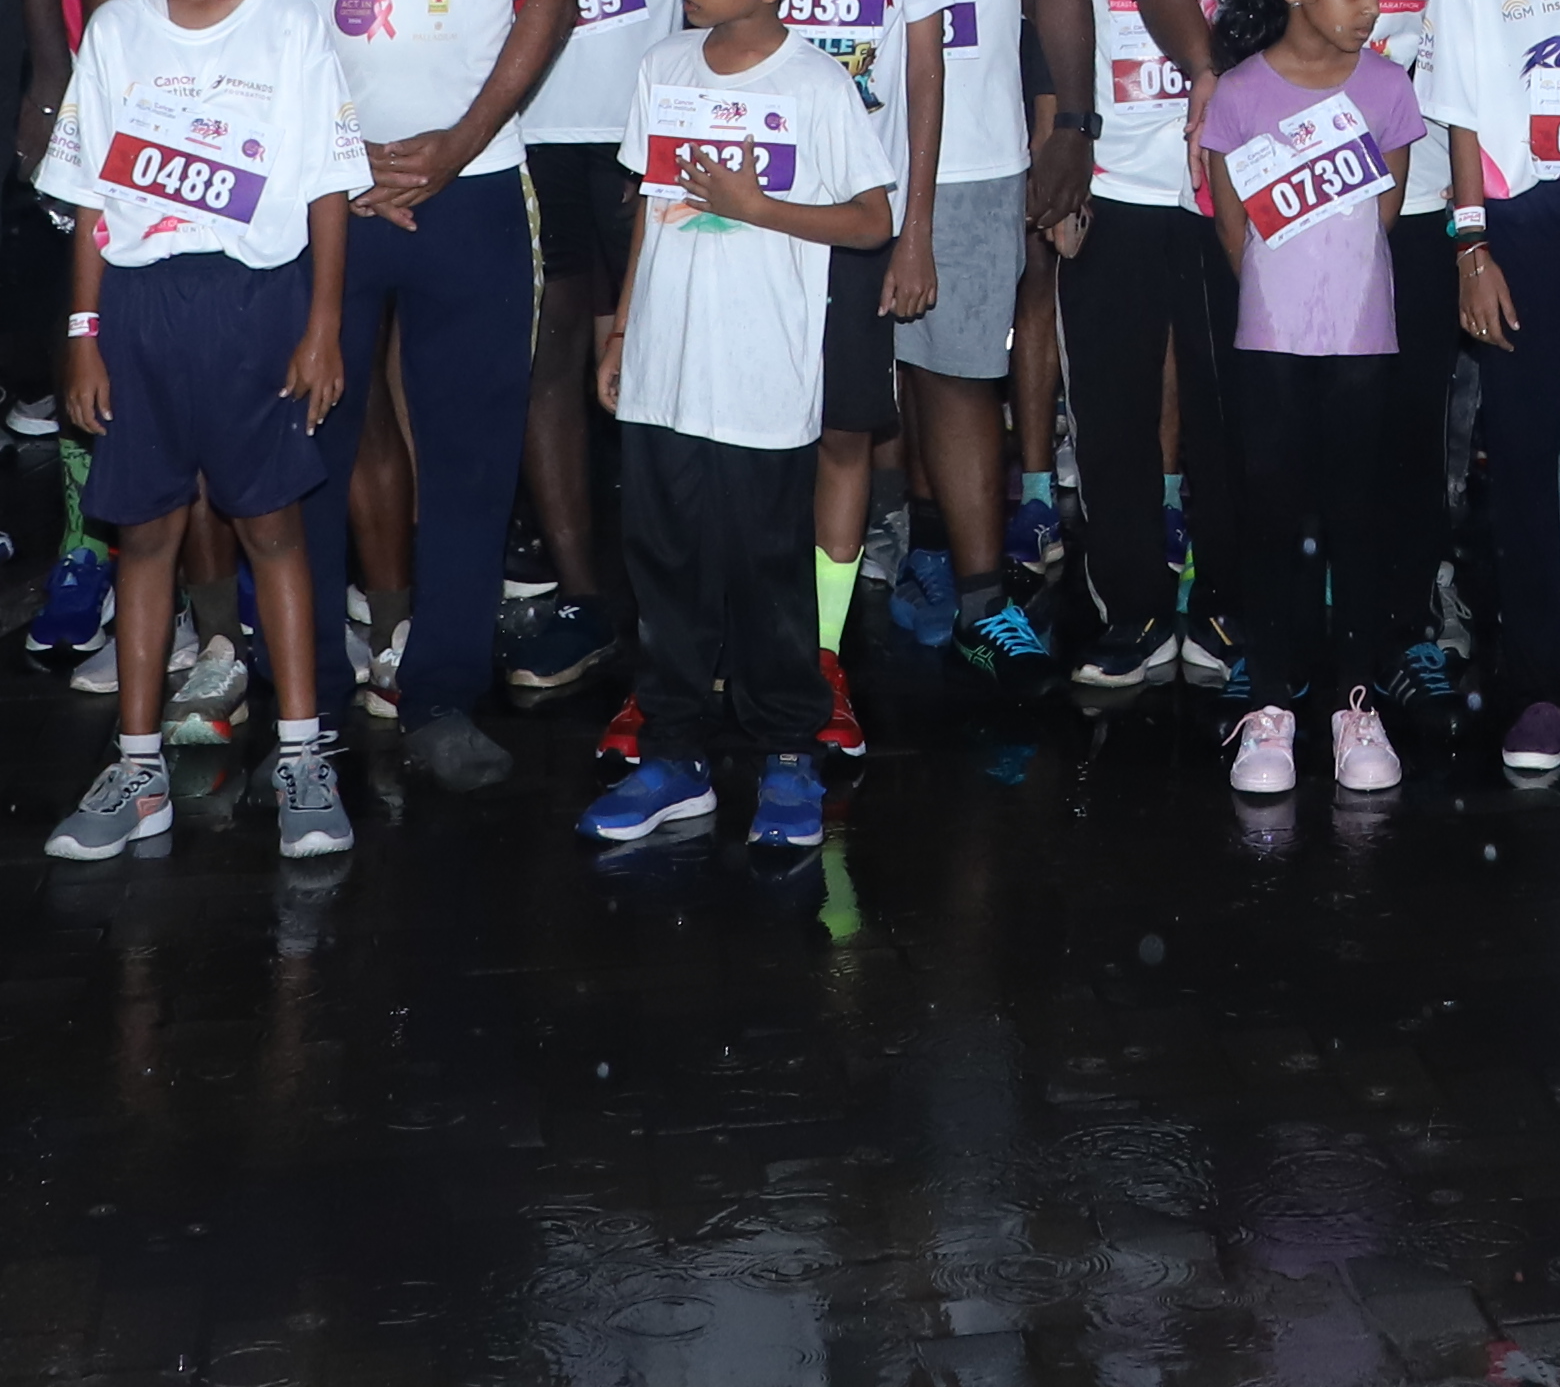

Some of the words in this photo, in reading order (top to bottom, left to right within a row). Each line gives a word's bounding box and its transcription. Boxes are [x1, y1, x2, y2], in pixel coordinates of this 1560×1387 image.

[1502, 6, 1534, 22] MGM
[131, 147, 236, 209] 0488
[1271, 149, 1364, 219] 0730
